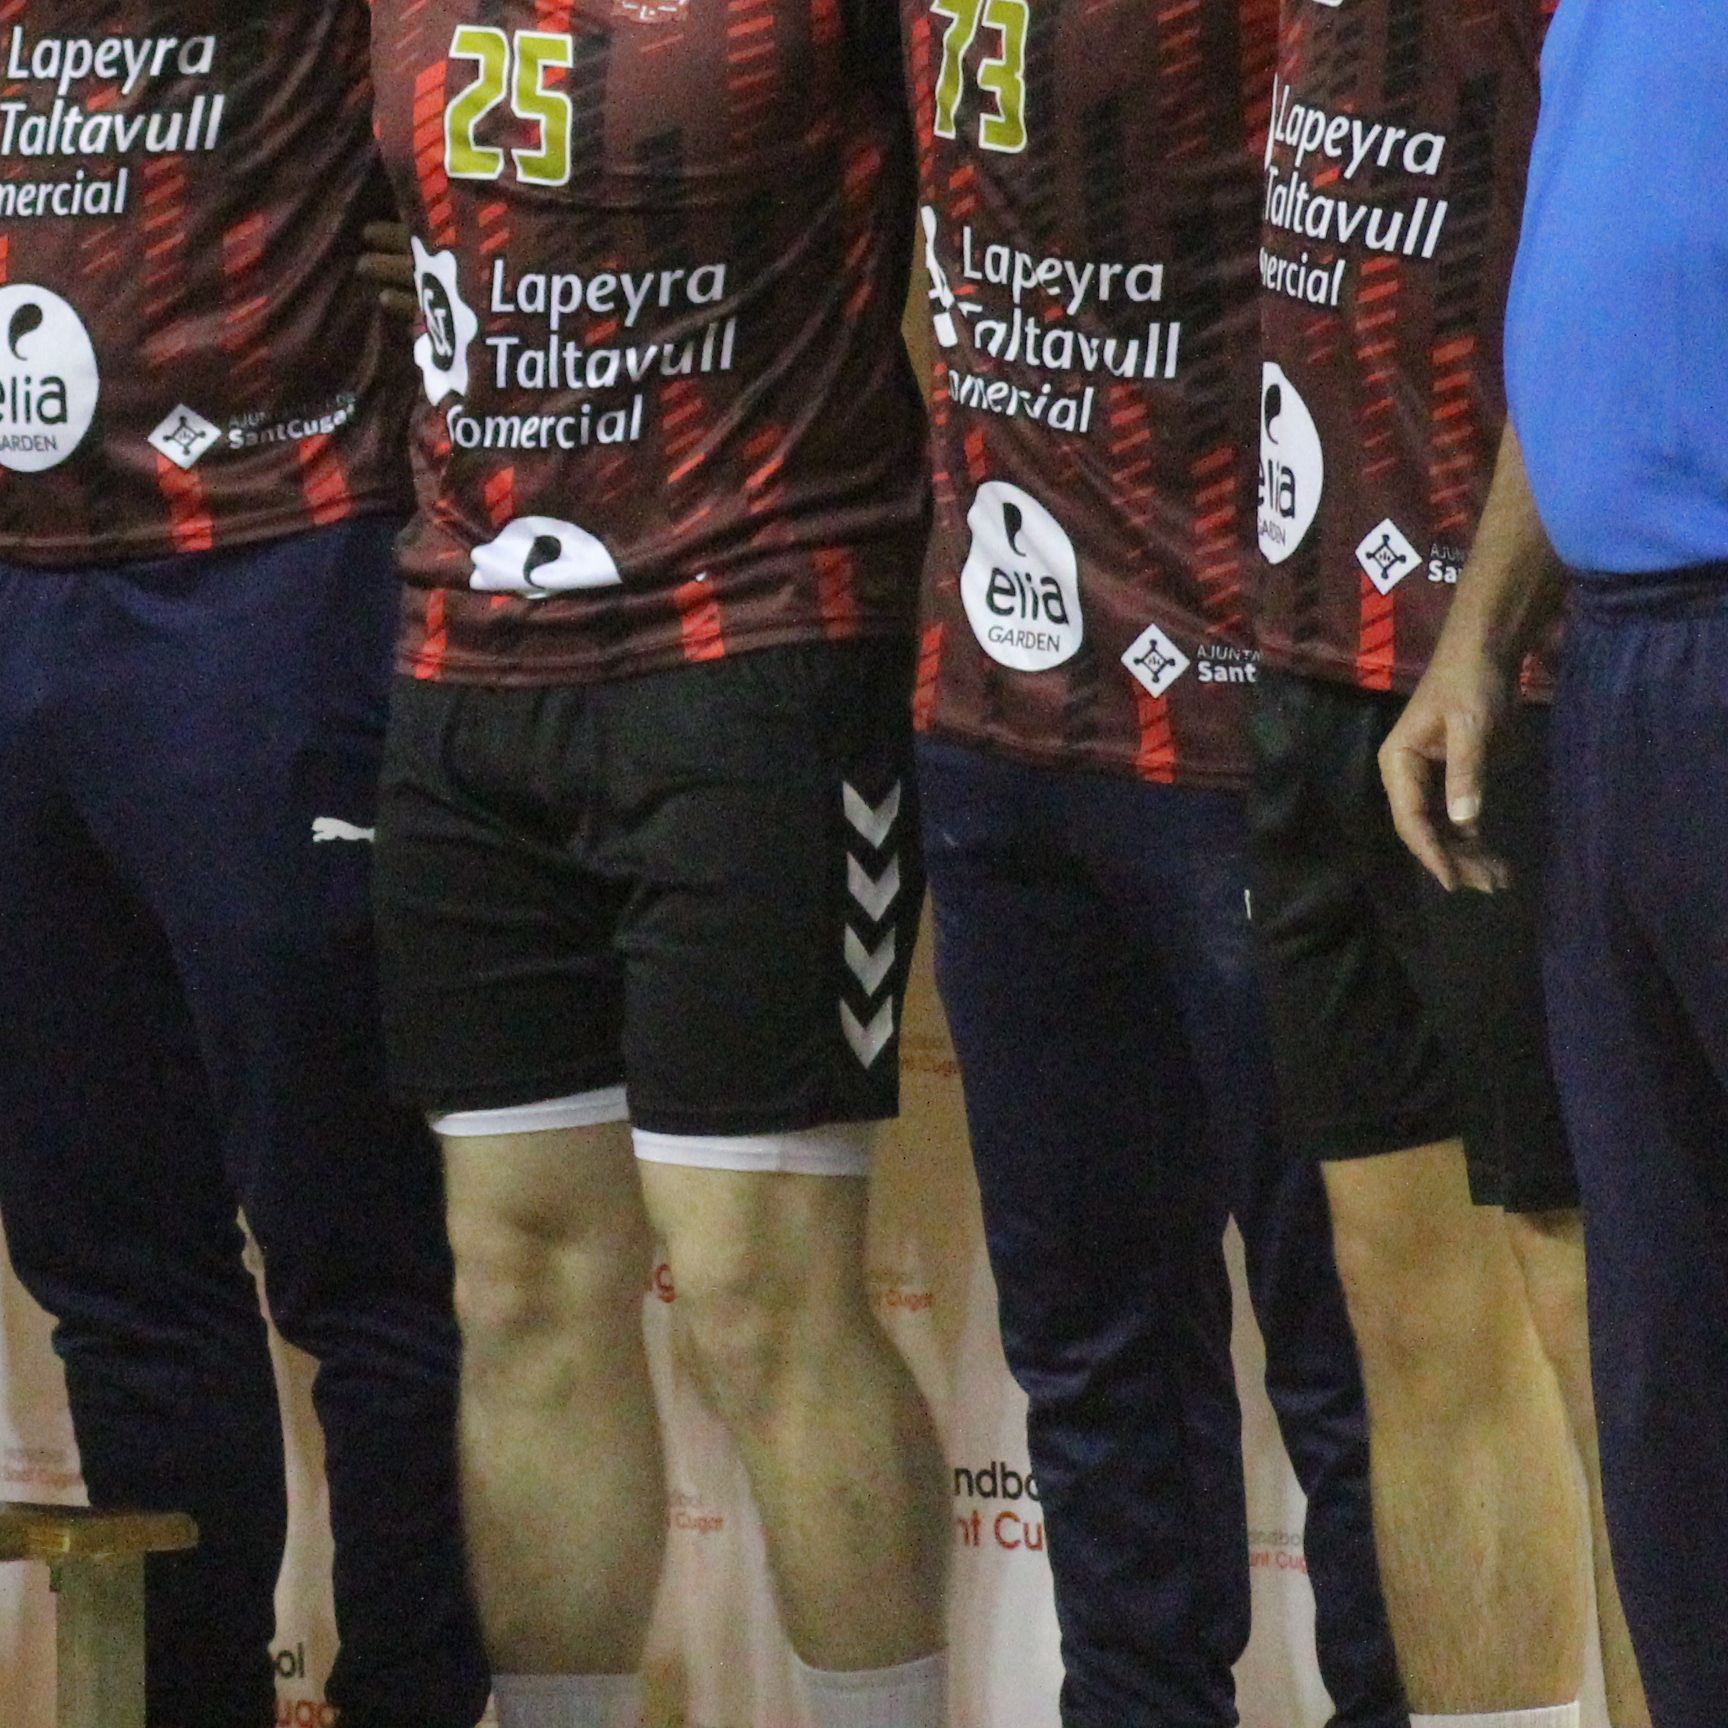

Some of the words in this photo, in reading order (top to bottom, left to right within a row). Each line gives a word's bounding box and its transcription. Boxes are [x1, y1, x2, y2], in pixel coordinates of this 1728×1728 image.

[7, 25, 218, 95] Lapeyra
[0, 92, 226, 157] Taltavull
[444, 23, 574, 187] 25
[1276, 83, 1447, 179] Lapeyra
[490, 258, 727, 330] Lapeyra
[962, 225, 1165, 316] Lapeyra
[486, 317, 737, 391] Taltavull
[986, 567, 1072, 626] elia
[988, 625, 1062, 654] GARDEN
